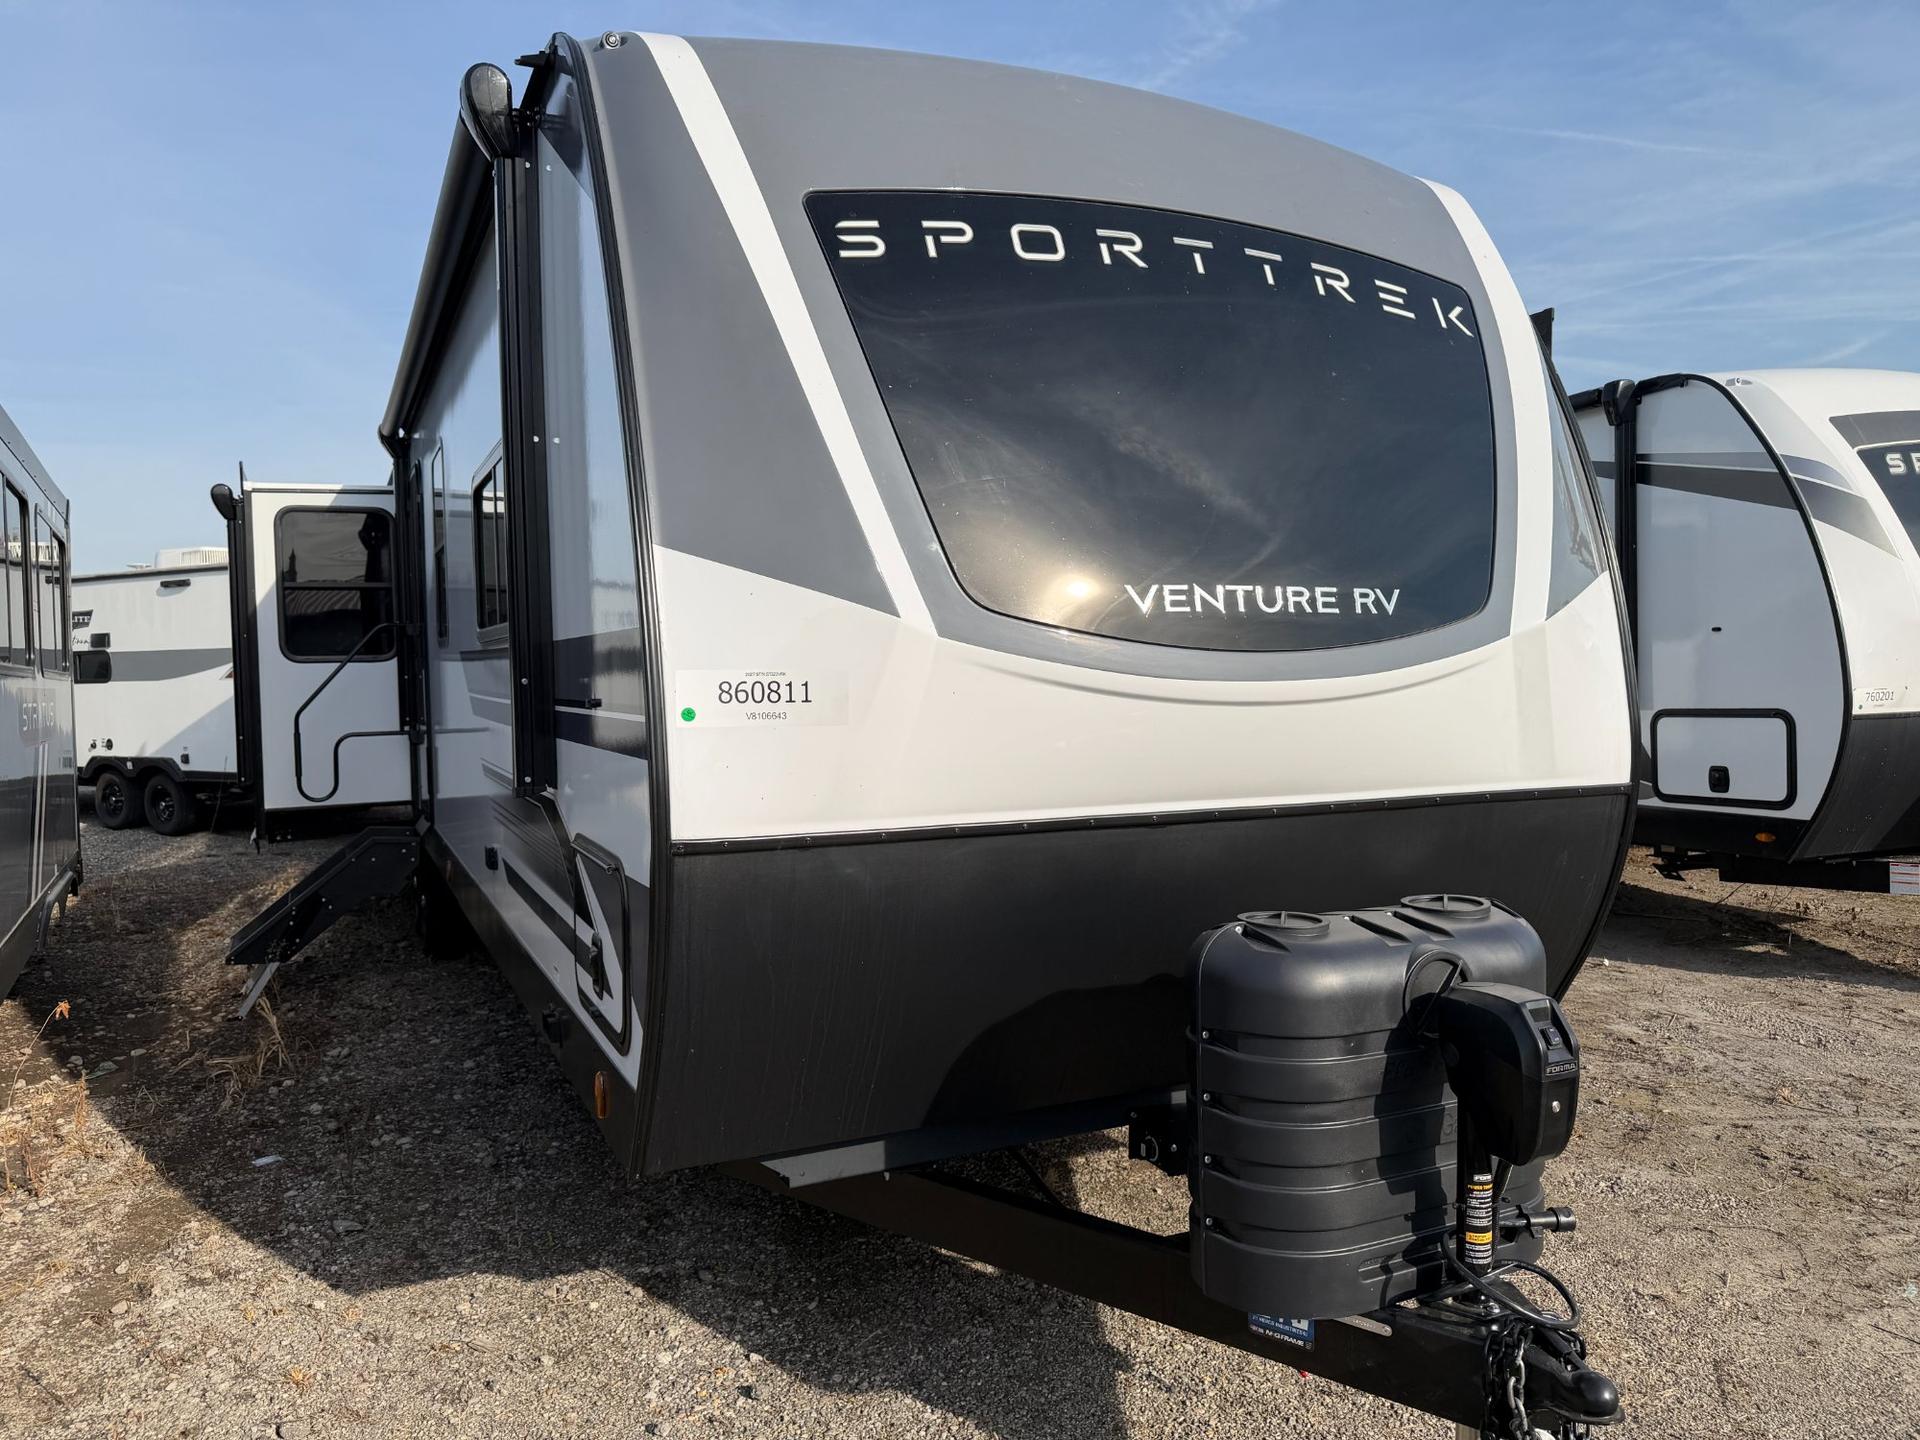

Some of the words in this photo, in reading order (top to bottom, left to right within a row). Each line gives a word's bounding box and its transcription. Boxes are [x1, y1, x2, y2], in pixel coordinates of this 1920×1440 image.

[835, 220, 1474, 337] SPORTTREK
[1124, 583, 1340, 615] VENTURE
[1353, 587, 1400, 616] RV
[718, 680, 812, 704] 860811
[1865, 691, 1894, 702] 760201
[746, 711, 787, 720] V8106643
[1546, 1063, 1576, 1074] FORMA
